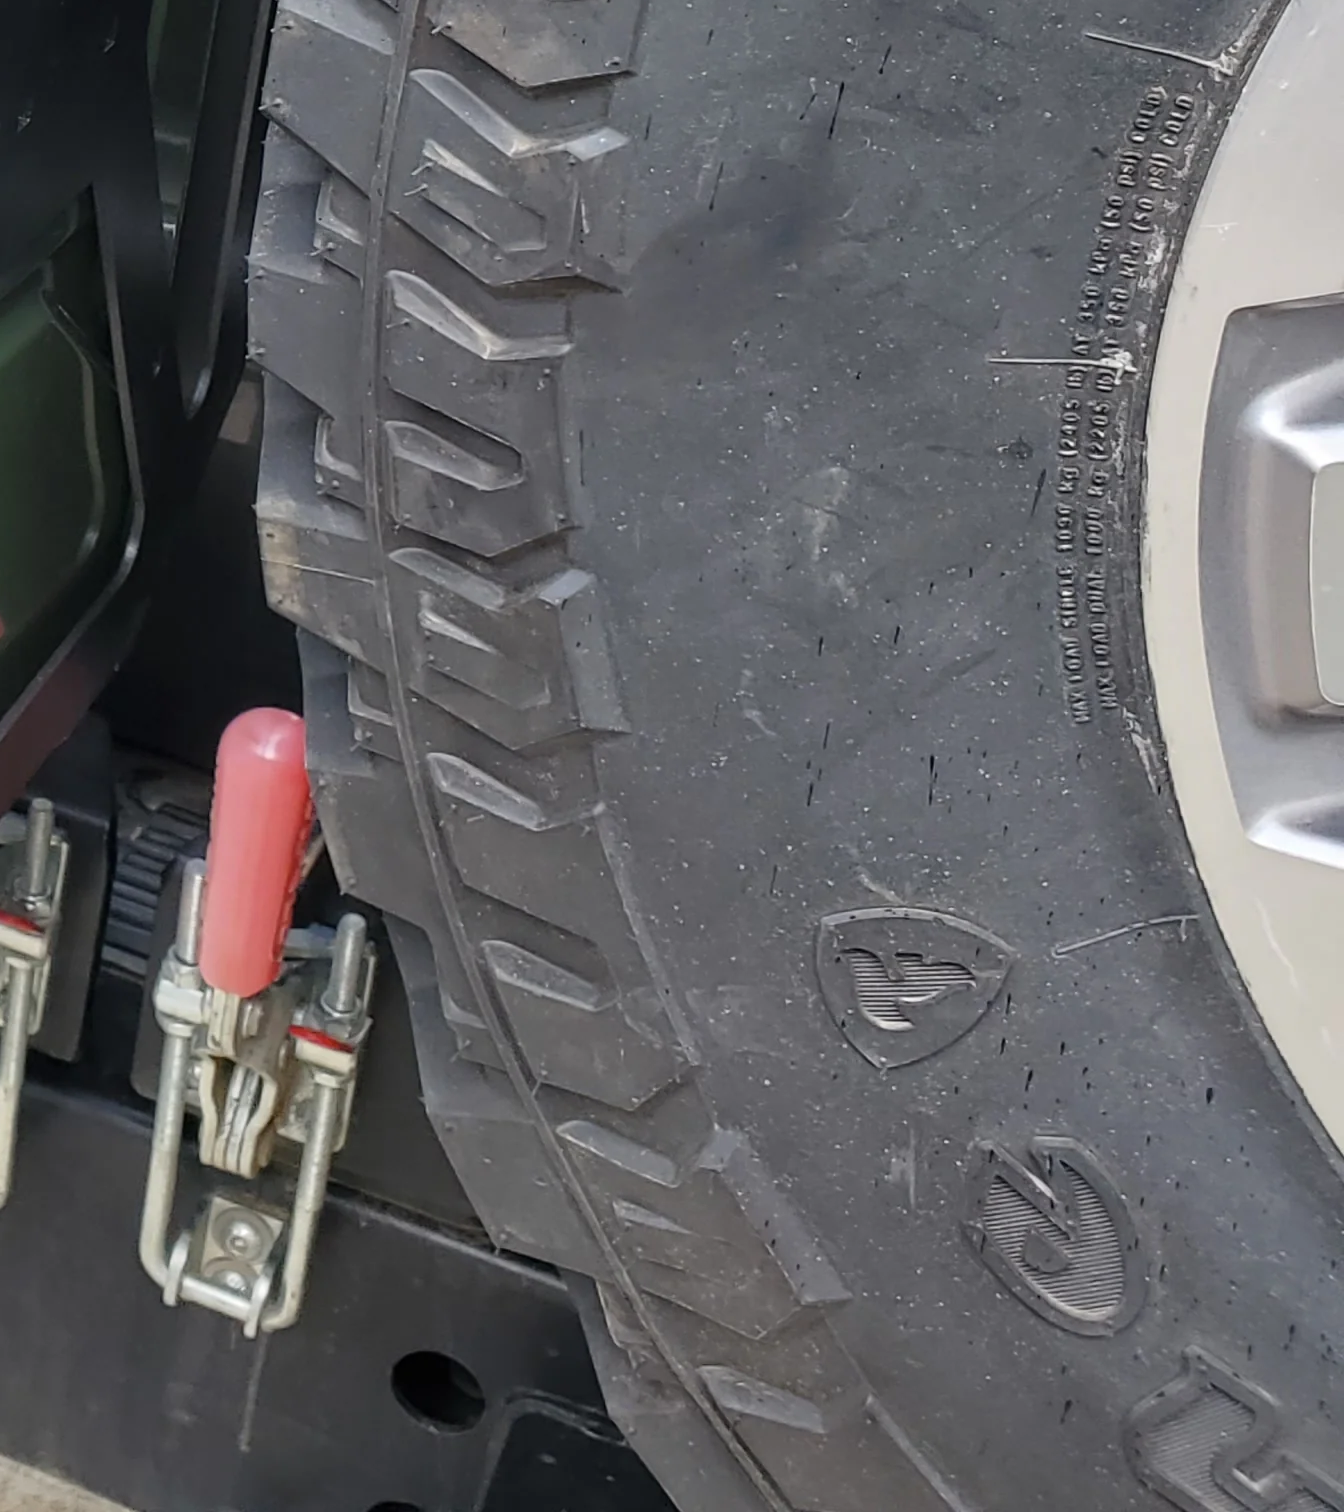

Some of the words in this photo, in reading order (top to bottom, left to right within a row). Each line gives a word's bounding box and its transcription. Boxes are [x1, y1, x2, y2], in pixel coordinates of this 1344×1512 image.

[1159, 93, 1195, 148] COLD
[1117, 149, 1143, 188] psi)
[1146, 151, 1174, 191] psi)
[1101, 194, 1126, 229] (50
[1129, 196, 1154, 233] (50
[1089, 237, 1115, 276] kPa
[1118, 241, 1143, 279] kPa
[1078, 284, 1101, 324] 350
[1089, 399, 1111, 461] (2205
[1058, 465, 1080, 494] kg
[1087, 470, 1110, 498] kg
[1058, 566, 1079, 628] SINGLE
